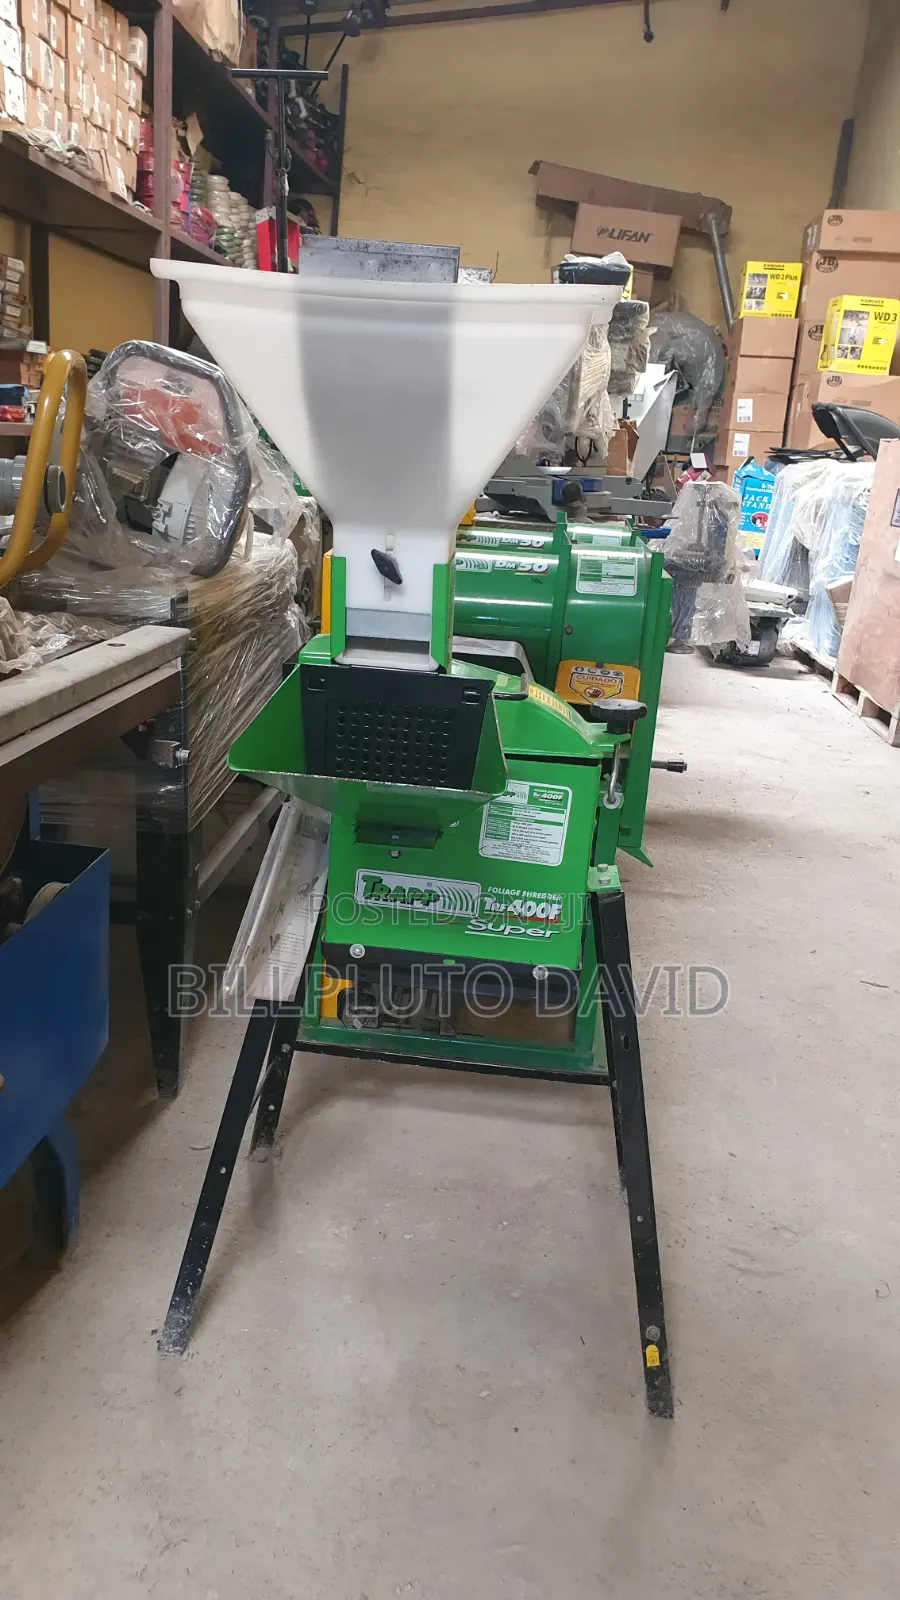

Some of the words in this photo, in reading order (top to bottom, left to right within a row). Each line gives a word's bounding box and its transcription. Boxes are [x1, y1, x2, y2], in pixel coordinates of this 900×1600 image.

[608, 228, 651, 243] LIFAN
[874, 311, 891, 322] WD
[891, 312, 898, 322] 3
[744, 493, 769, 503] JACK
[576, 674, 618, 683] CUIDADO
[361, 874, 441, 907] TRAPP
[487, 886, 521, 896] FOLIAGE
[522, 890, 563, 901] SHREDDER
[466, 919, 561, 938] Super
